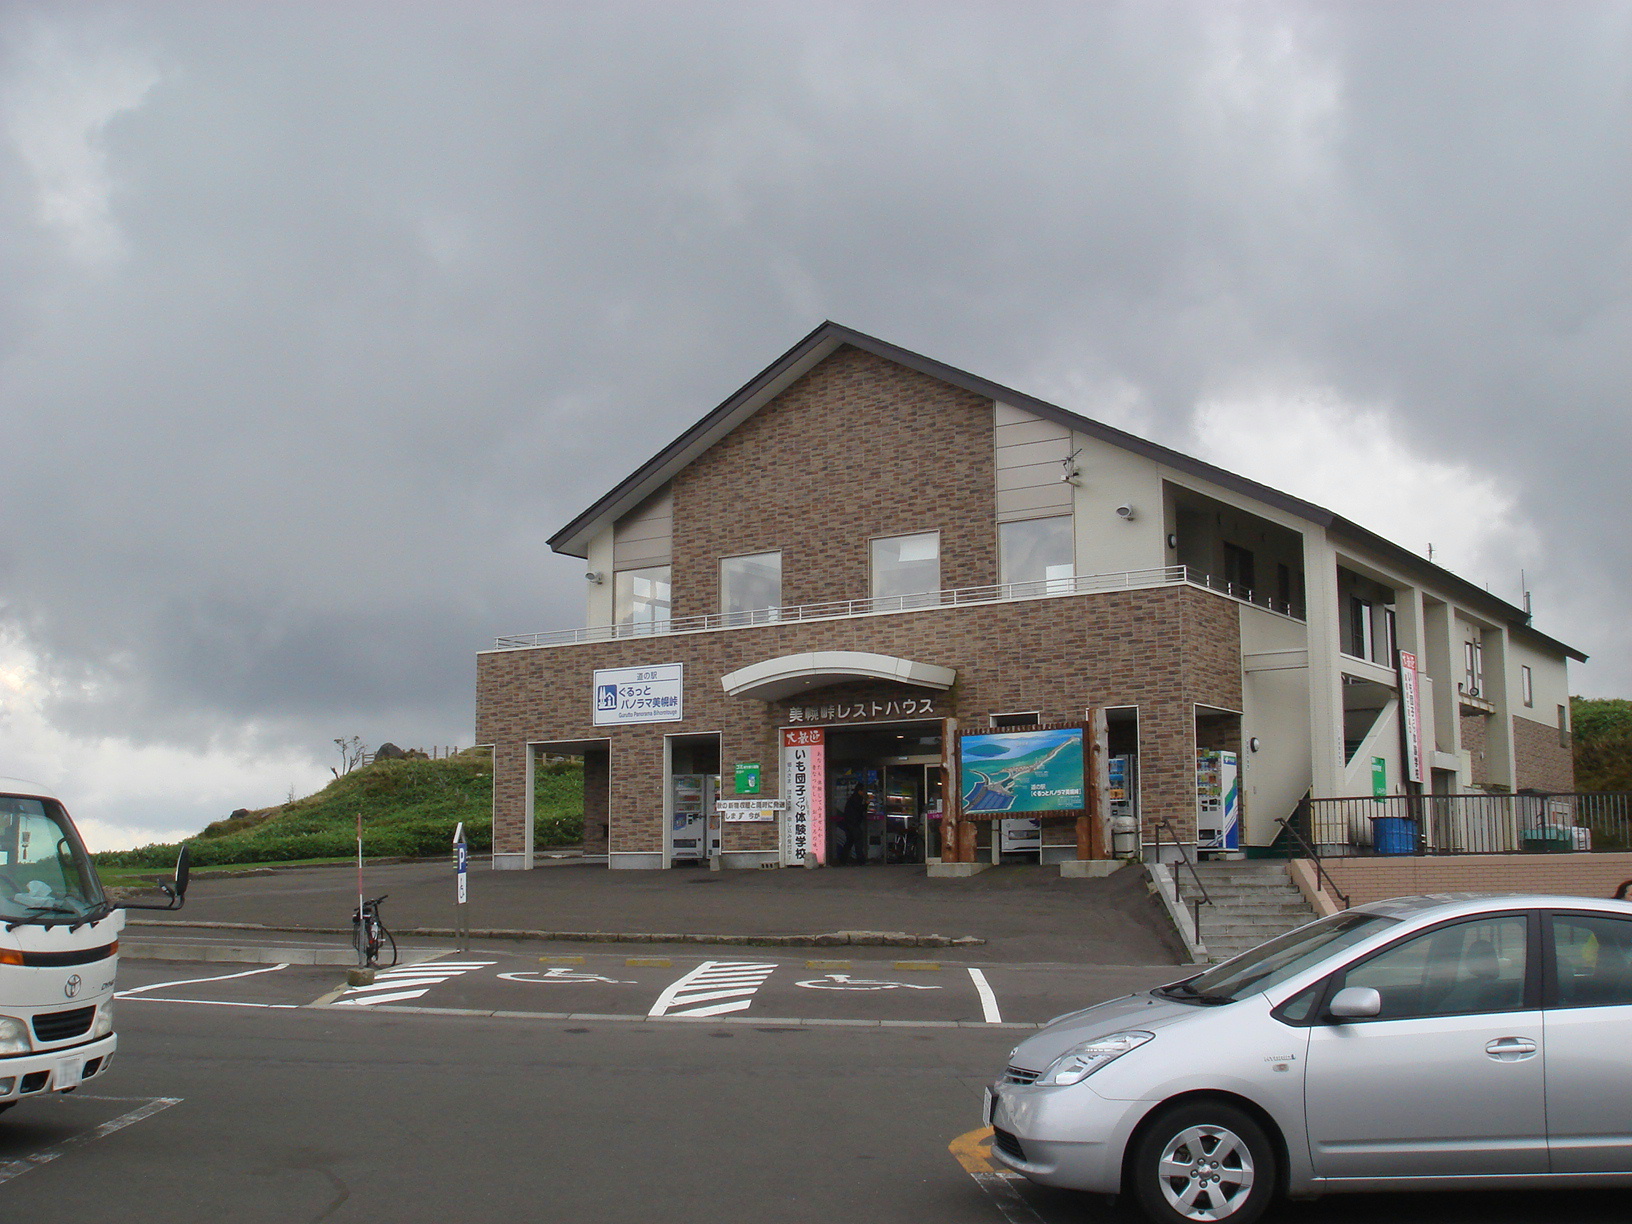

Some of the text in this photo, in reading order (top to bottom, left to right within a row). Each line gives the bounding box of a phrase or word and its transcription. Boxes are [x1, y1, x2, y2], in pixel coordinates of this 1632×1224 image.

[637, 671, 658, 681] 道の駅
[618, 685, 651, 697] ぐるっと
[621, 695, 678, 709] パノラマ美幌峠
[789, 698, 934, 723] 美幌峠レストハウス
[795, 749, 807, 859] いも団子づくり体験学校
[459, 847, 465, 870] P
